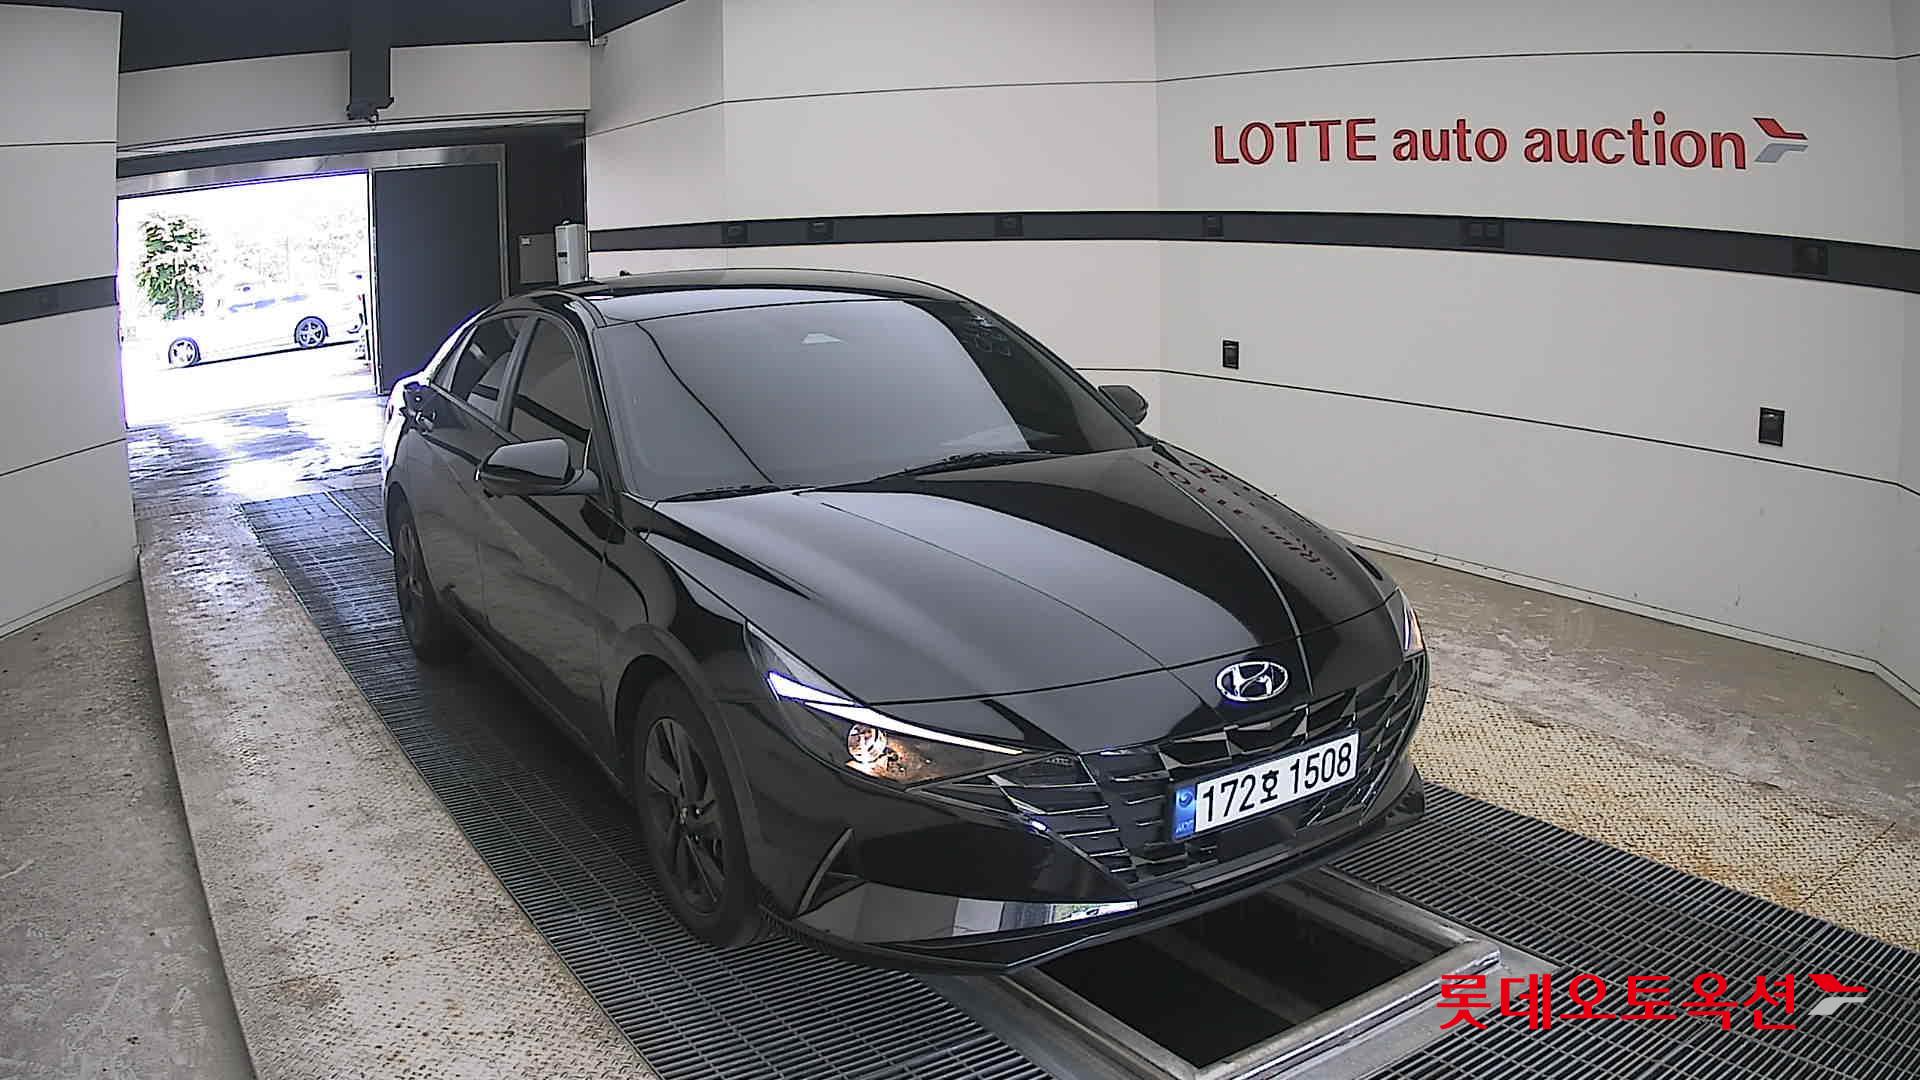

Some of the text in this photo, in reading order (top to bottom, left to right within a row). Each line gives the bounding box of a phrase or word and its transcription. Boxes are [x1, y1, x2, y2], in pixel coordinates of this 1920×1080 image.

[1214, 110, 1747, 170] LOTTE auto auction
[1202, 741, 1353, 823] 172호 1508
